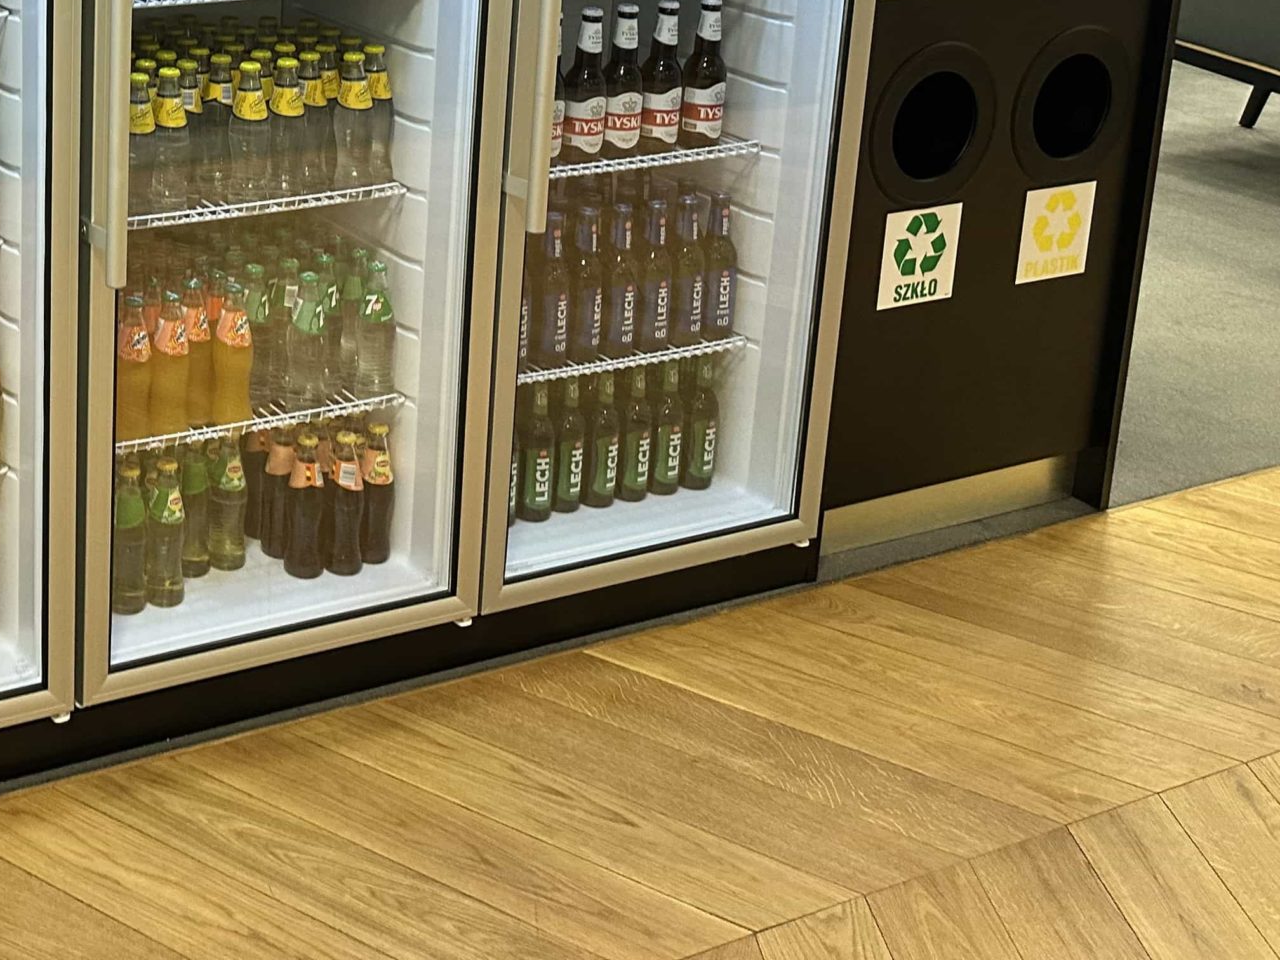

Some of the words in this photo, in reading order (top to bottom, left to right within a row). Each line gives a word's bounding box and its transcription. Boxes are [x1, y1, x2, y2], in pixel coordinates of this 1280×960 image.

[1024, 256, 1079, 277] PLASTIK
[658, 288, 668, 320] LECH
[693, 282, 702, 314] LECH
[719, 277, 730, 308] LECH
[893, 279, 937, 303] SZKŁO
[558, 301, 566, 334] LECH
[594, 294, 602, 327] LECH
[624, 292, 634, 324] LECH
[606, 442, 618, 488] LECH
[638, 437, 650, 482] LECH
[668, 432, 682, 476] LECH
[703, 428, 716, 470] LECH
[536, 458, 550, 501] LECH
[570, 448, 583, 492] LECH
